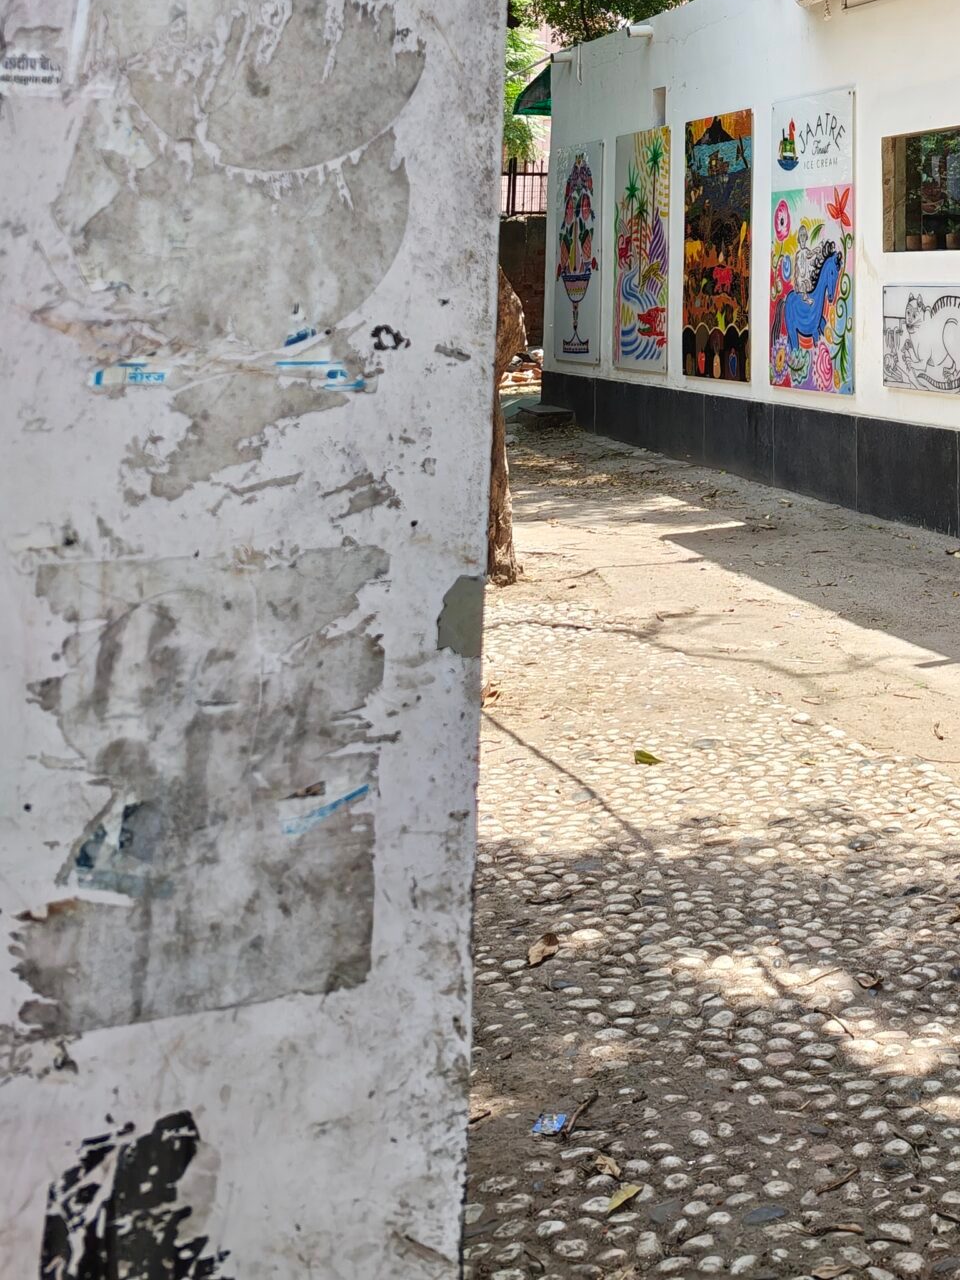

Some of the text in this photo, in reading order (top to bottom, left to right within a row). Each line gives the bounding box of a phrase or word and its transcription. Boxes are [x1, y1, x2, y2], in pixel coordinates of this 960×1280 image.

[798, 112, 846, 154] JAATRE
[803, 157, 838, 170] ICE CREAM
